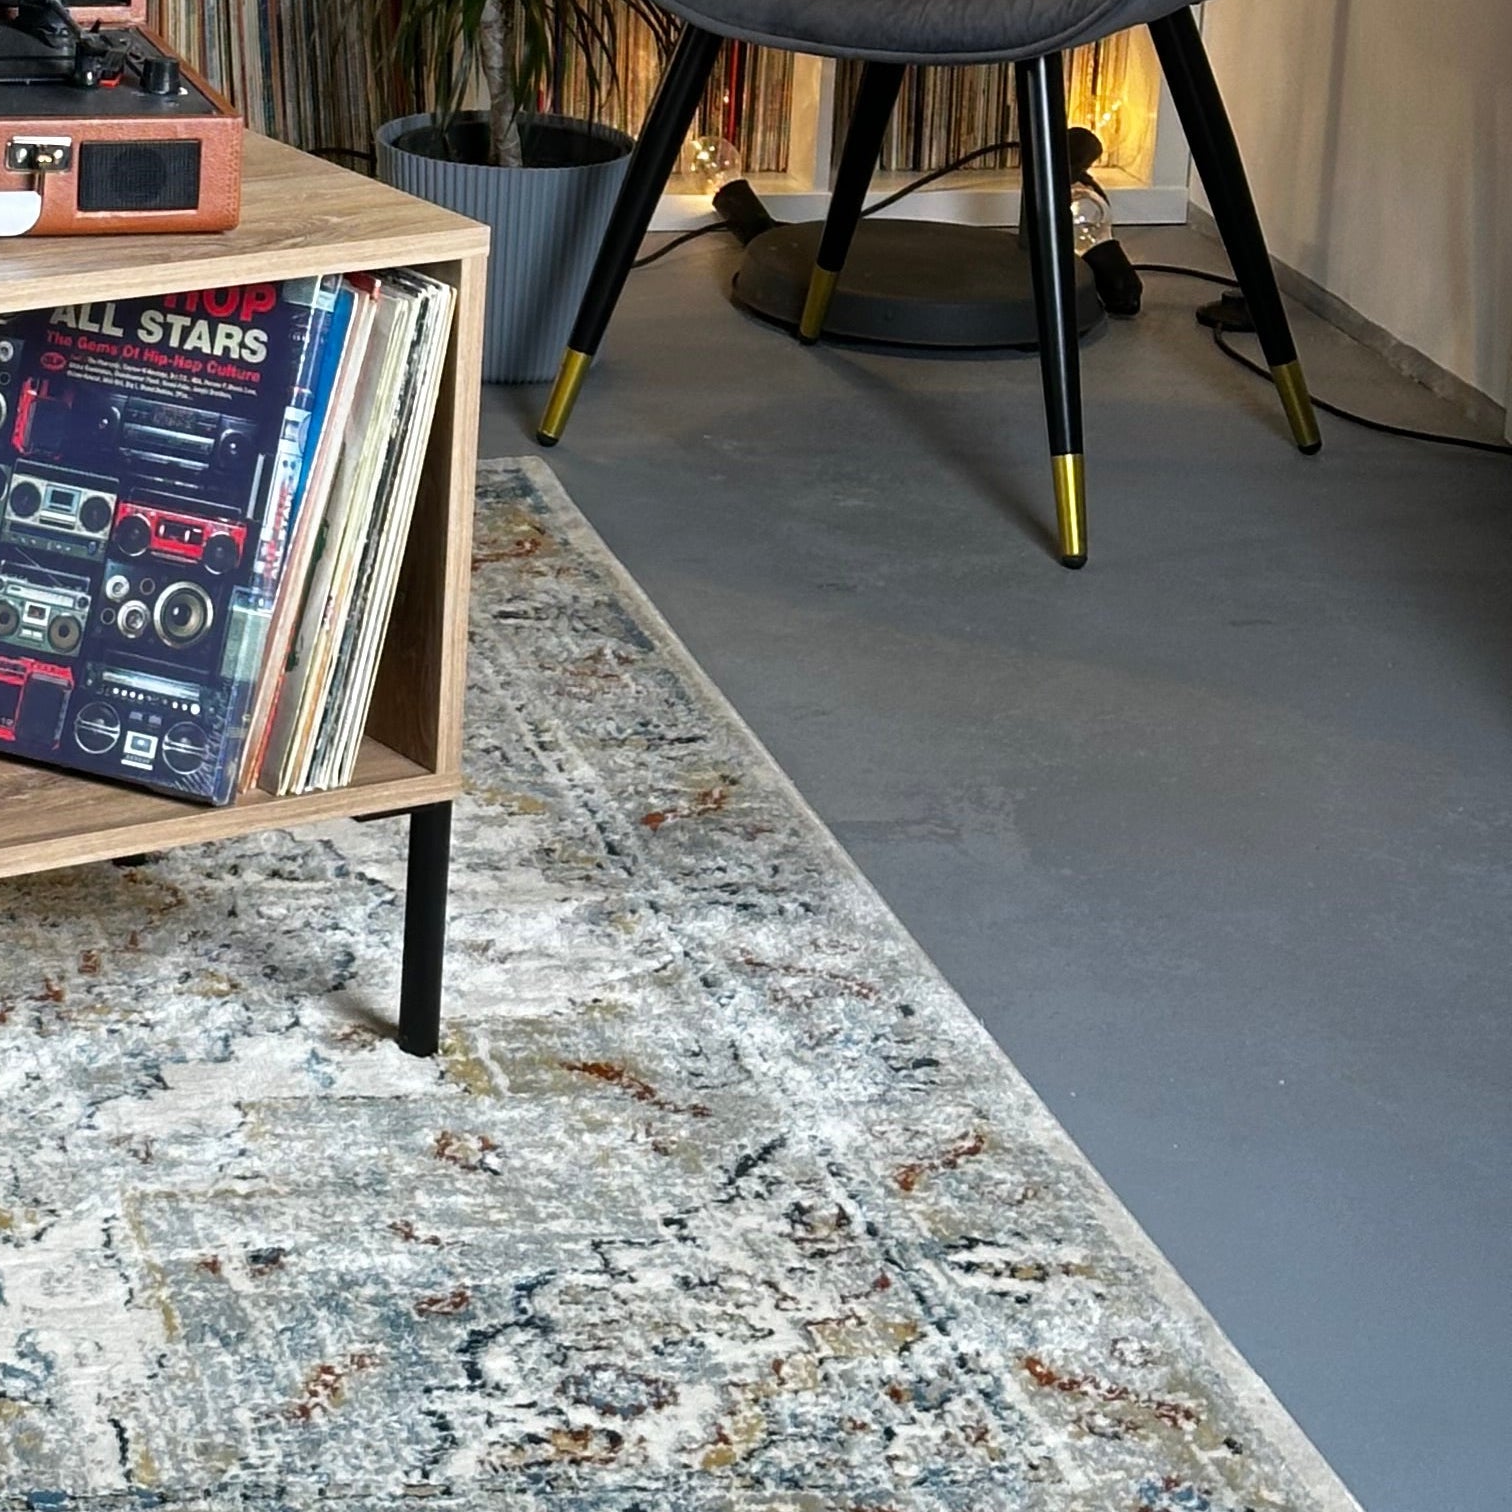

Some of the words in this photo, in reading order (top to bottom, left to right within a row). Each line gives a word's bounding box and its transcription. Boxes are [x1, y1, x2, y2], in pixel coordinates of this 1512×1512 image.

[46, 329, 73, 348] The
[77, 335, 119, 357] Gems
[122, 344, 141, 361] Of
[143, 350, 203, 375] Hip-Hop
[206, 360, 262, 384] Culture
[48, 302, 125, 338] ALL
[137, 309, 269, 364] STARS
